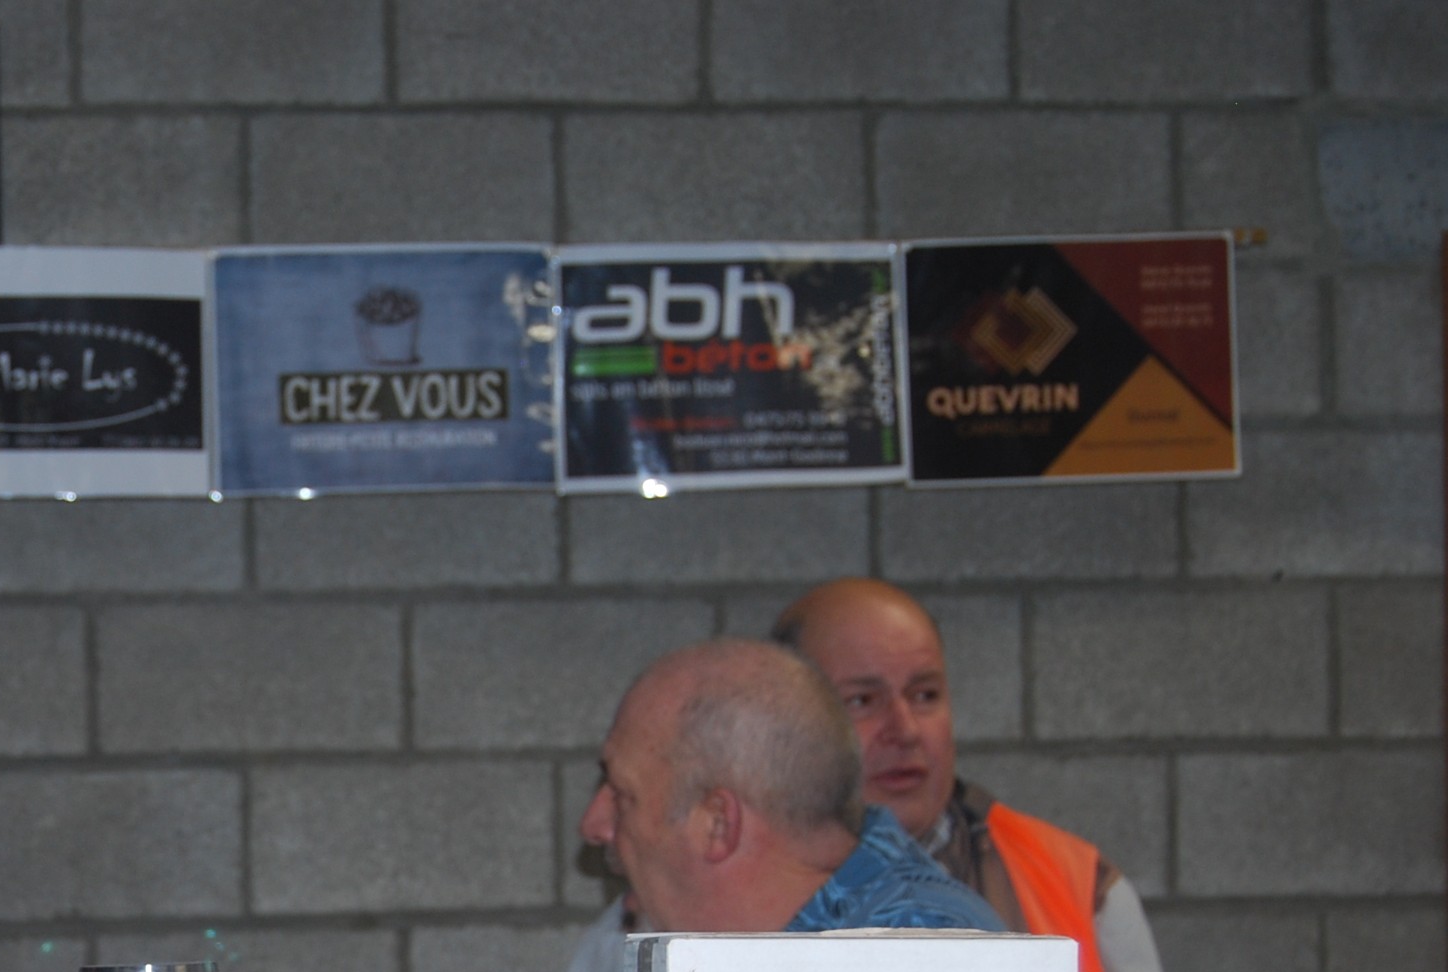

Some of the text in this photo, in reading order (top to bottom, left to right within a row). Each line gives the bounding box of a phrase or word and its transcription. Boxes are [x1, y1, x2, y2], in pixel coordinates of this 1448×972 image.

[573, 266, 795, 344] abh
[282, 371, 502, 421] CHEZ VOUS
[926, 384, 1080, 418] QUEVRIN
